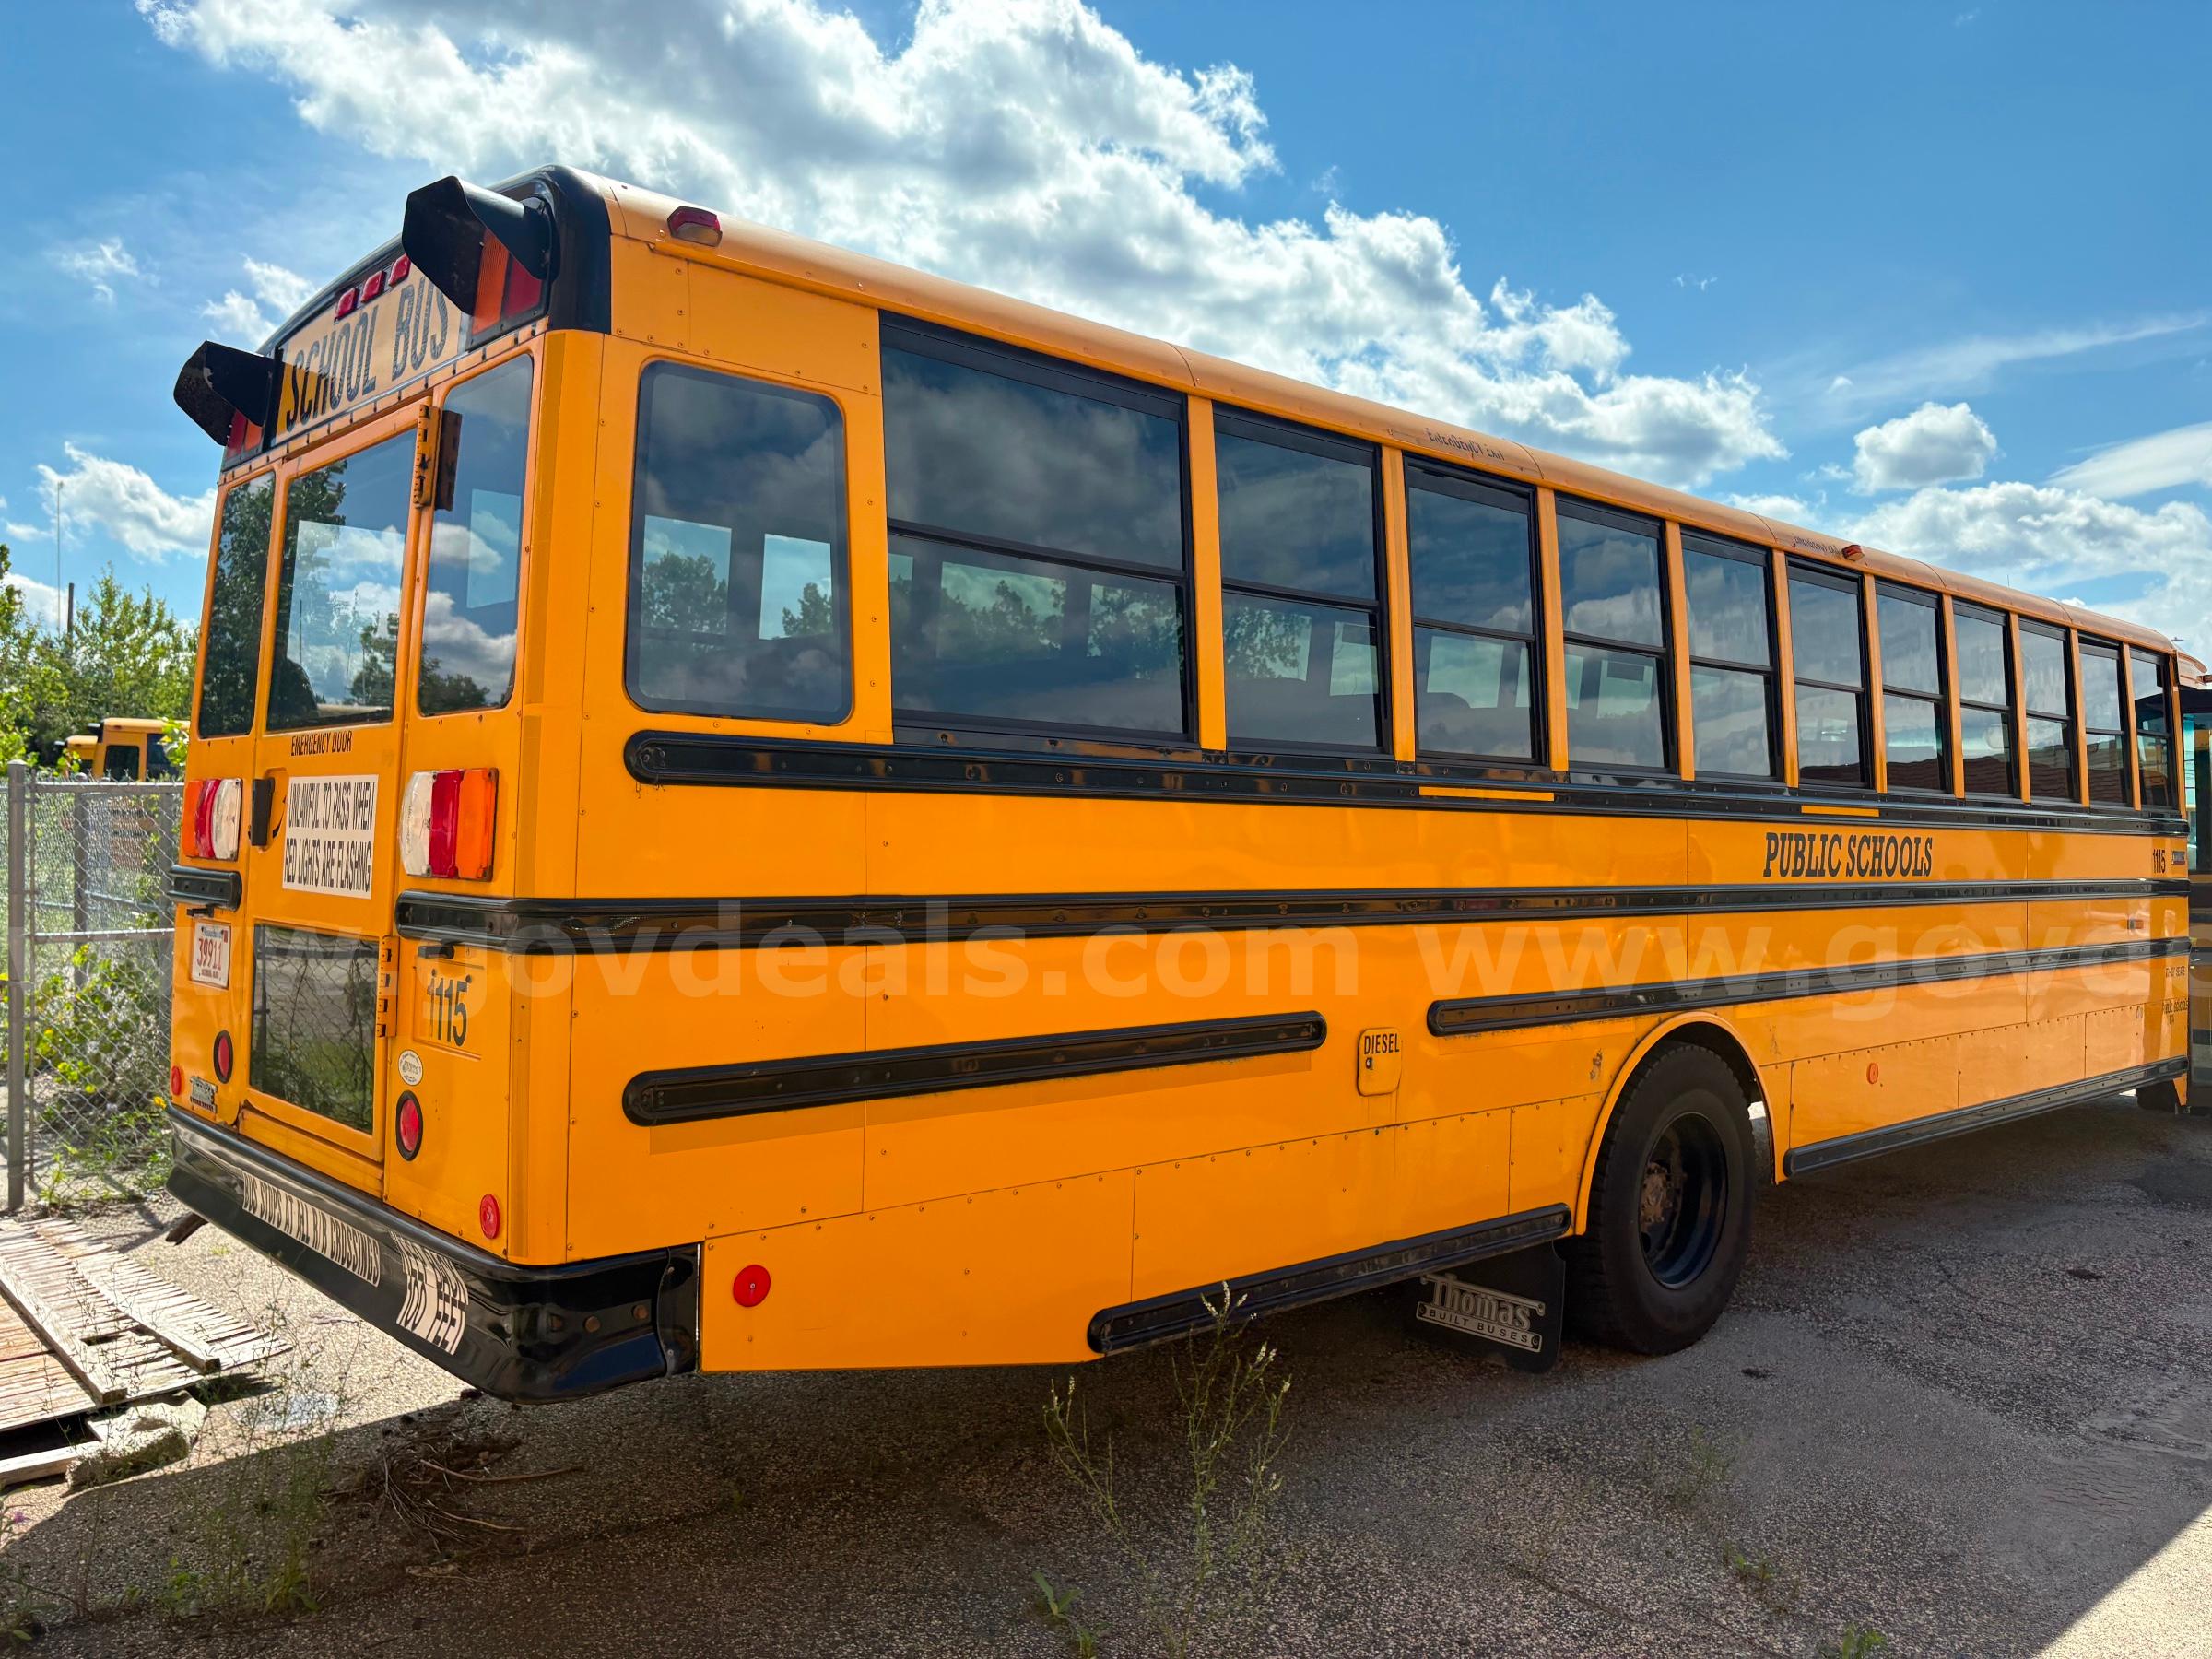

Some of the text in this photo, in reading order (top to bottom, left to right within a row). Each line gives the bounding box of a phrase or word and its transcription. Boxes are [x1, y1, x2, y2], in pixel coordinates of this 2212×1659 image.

[286, 276, 448, 432] SCHOOL BUS
[291, 731, 352, 757] EMERGENCY DOOR
[288, 782, 375, 830] UNLAWFUL TO PASS WHEN
[284, 838, 371, 892] RED LIGHTS ARE FLASHING
[1763, 832, 1933, 877] PUBLIC SCHOOLS
[2152, 849, 2166, 873] 1115
[197, 938, 221, 971] 39911
[427, 978, 468, 1047] 1115
[1364, 1033, 1400, 1054] DIESEL
[260, 1181, 282, 1228] STOPS
[284, 1194, 293, 1235] AT
[296, 1200, 310, 1244] ALL
[330, 1217, 380, 1285] CROSSINGS
[426, 1290, 465, 1352] FEET
[1427, 1273, 1535, 1331] Thomas
[1430, 1310, 1528, 1344] BUILT BUSES
